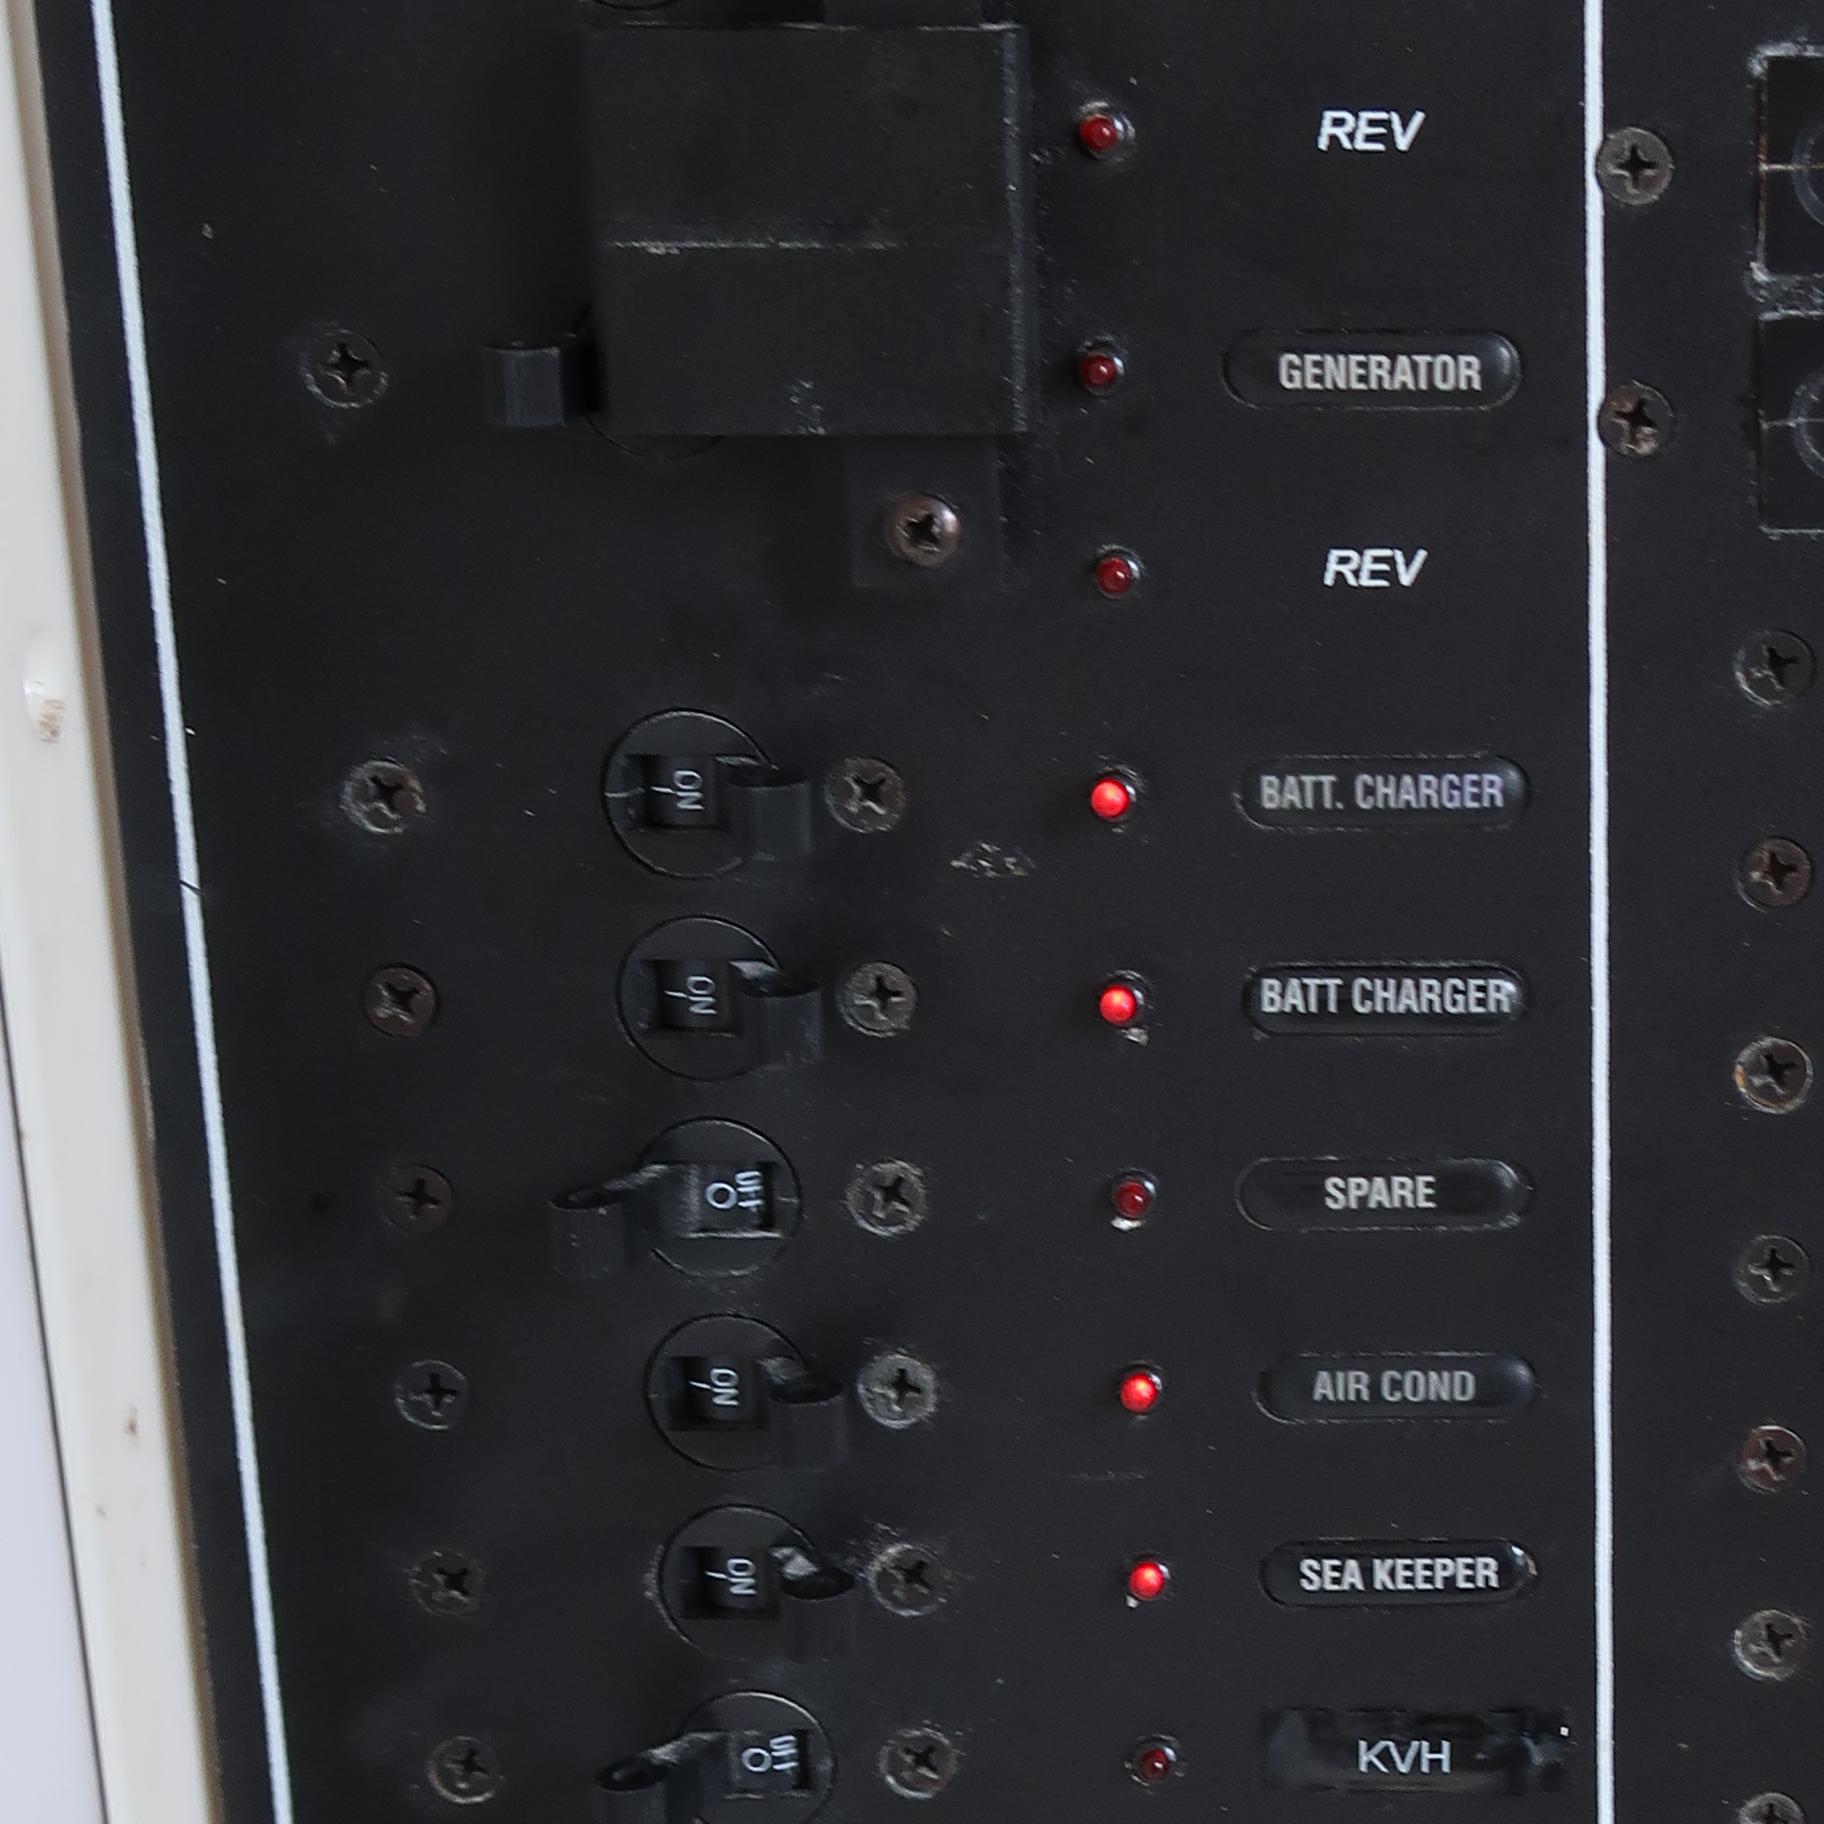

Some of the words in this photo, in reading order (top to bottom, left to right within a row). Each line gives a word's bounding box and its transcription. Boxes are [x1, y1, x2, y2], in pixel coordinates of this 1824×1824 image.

[1317, 110, 1425, 151] REV
[1279, 353, 1482, 391] GENERATOR
[1323, 548, 1428, 587] REV
[674, 770, 703, 810] ON
[1260, 775, 1344, 809] BATT.
[1356, 773, 1503, 809] CHARGER
[687, 976, 717, 1014] ON
[1261, 977, 1343, 1013] BATT
[1352, 977, 1512, 1014] CHARGER
[1325, 1175, 1437, 1210] SPARE
[710, 1368, 738, 1406] ON
[1313, 1370, 1370, 1401] AIR
[1381, 1370, 1475, 1402] COND
[727, 1558, 756, 1594] ON
[1300, 1559, 1365, 1591] SEA
[1373, 1557, 1499, 1590] KEEPER
[1358, 1740, 1450, 1773] KVH
